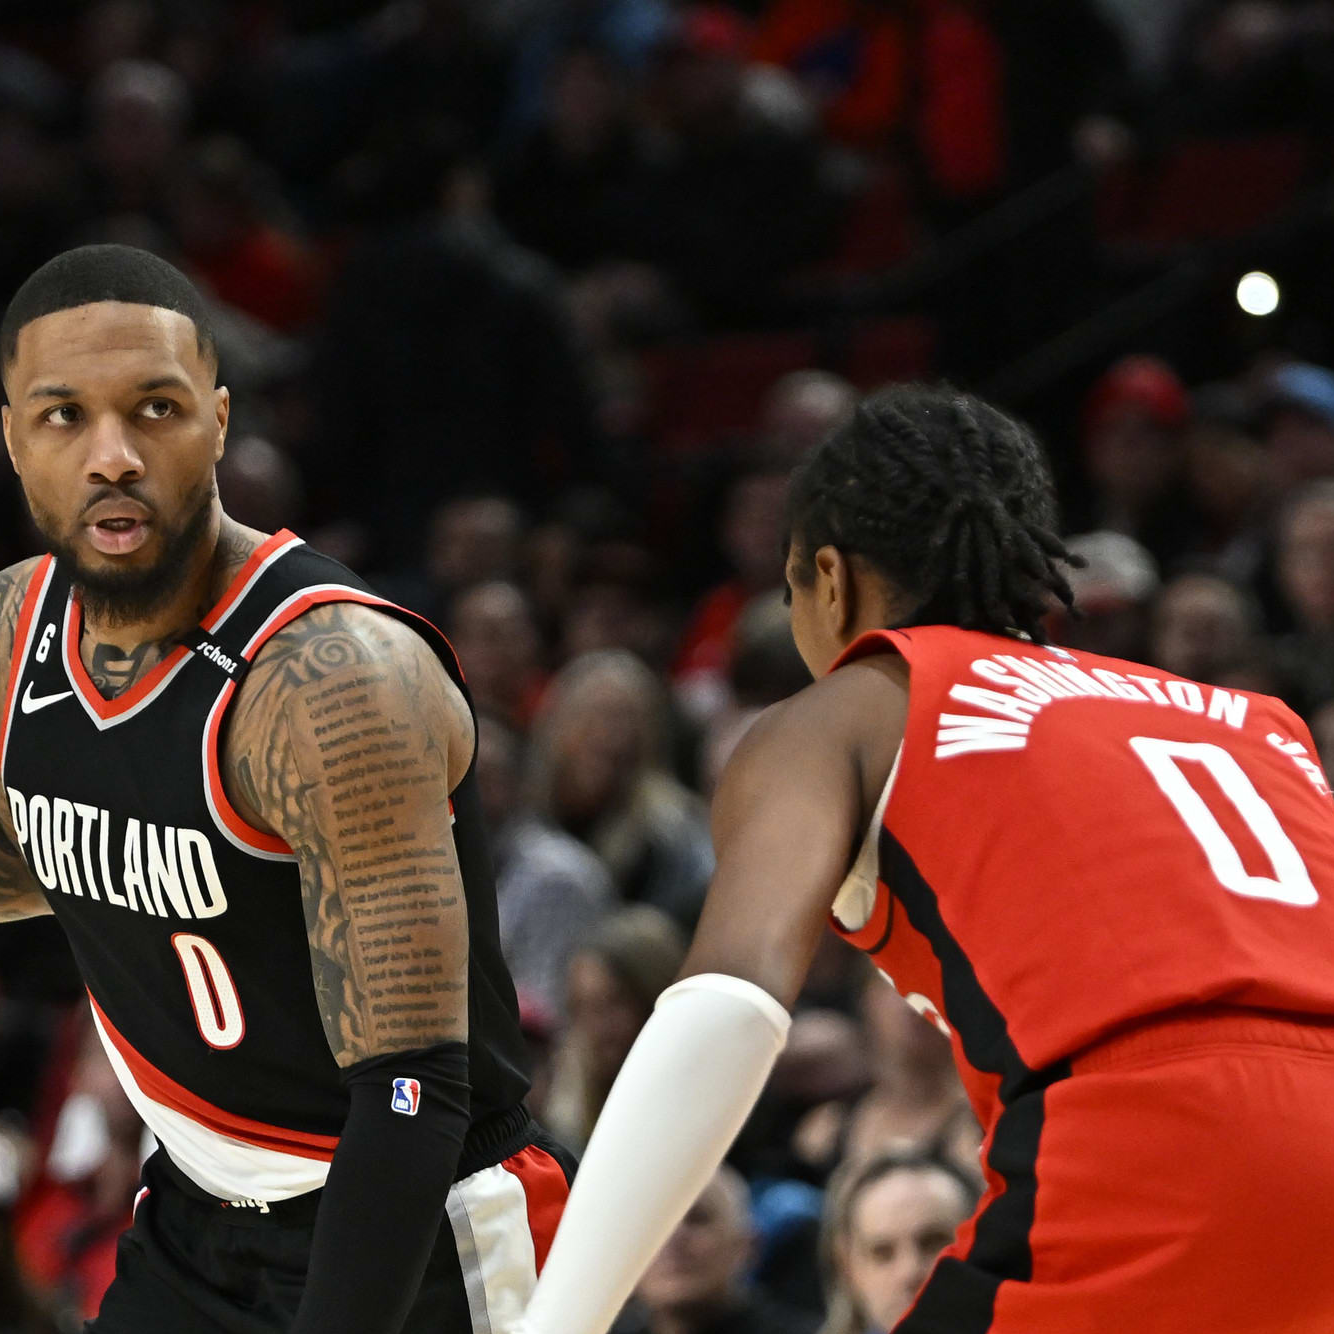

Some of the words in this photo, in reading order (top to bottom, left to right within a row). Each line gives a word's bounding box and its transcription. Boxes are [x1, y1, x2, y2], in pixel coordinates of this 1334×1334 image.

[35, 623, 57, 663] 6
[934, 654, 1249, 760] WASHINGTON
[6, 783, 228, 919] PORTLAND
[1129, 736, 1319, 906] 0
[171, 932, 246, 1050] 0
